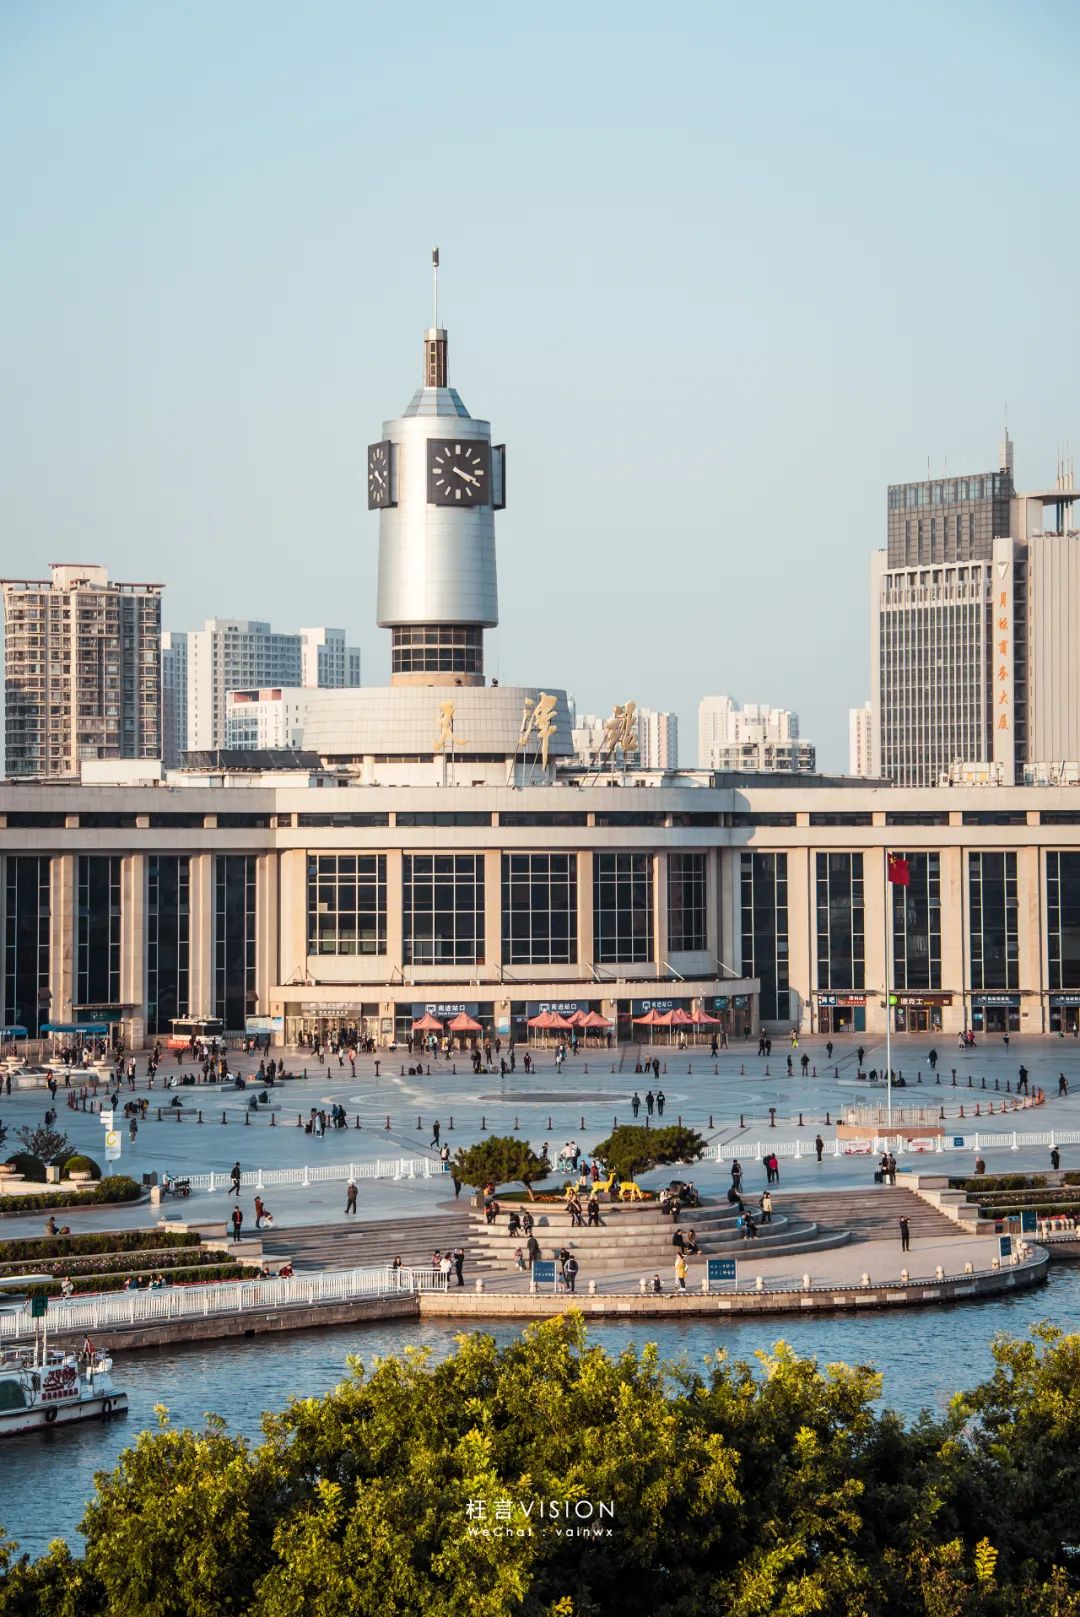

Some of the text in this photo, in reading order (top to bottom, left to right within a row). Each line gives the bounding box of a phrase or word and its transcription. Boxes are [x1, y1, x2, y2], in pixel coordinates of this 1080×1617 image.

[432, 692, 638, 772] 天津站
[900, 997, 924, 1005] 德克士
